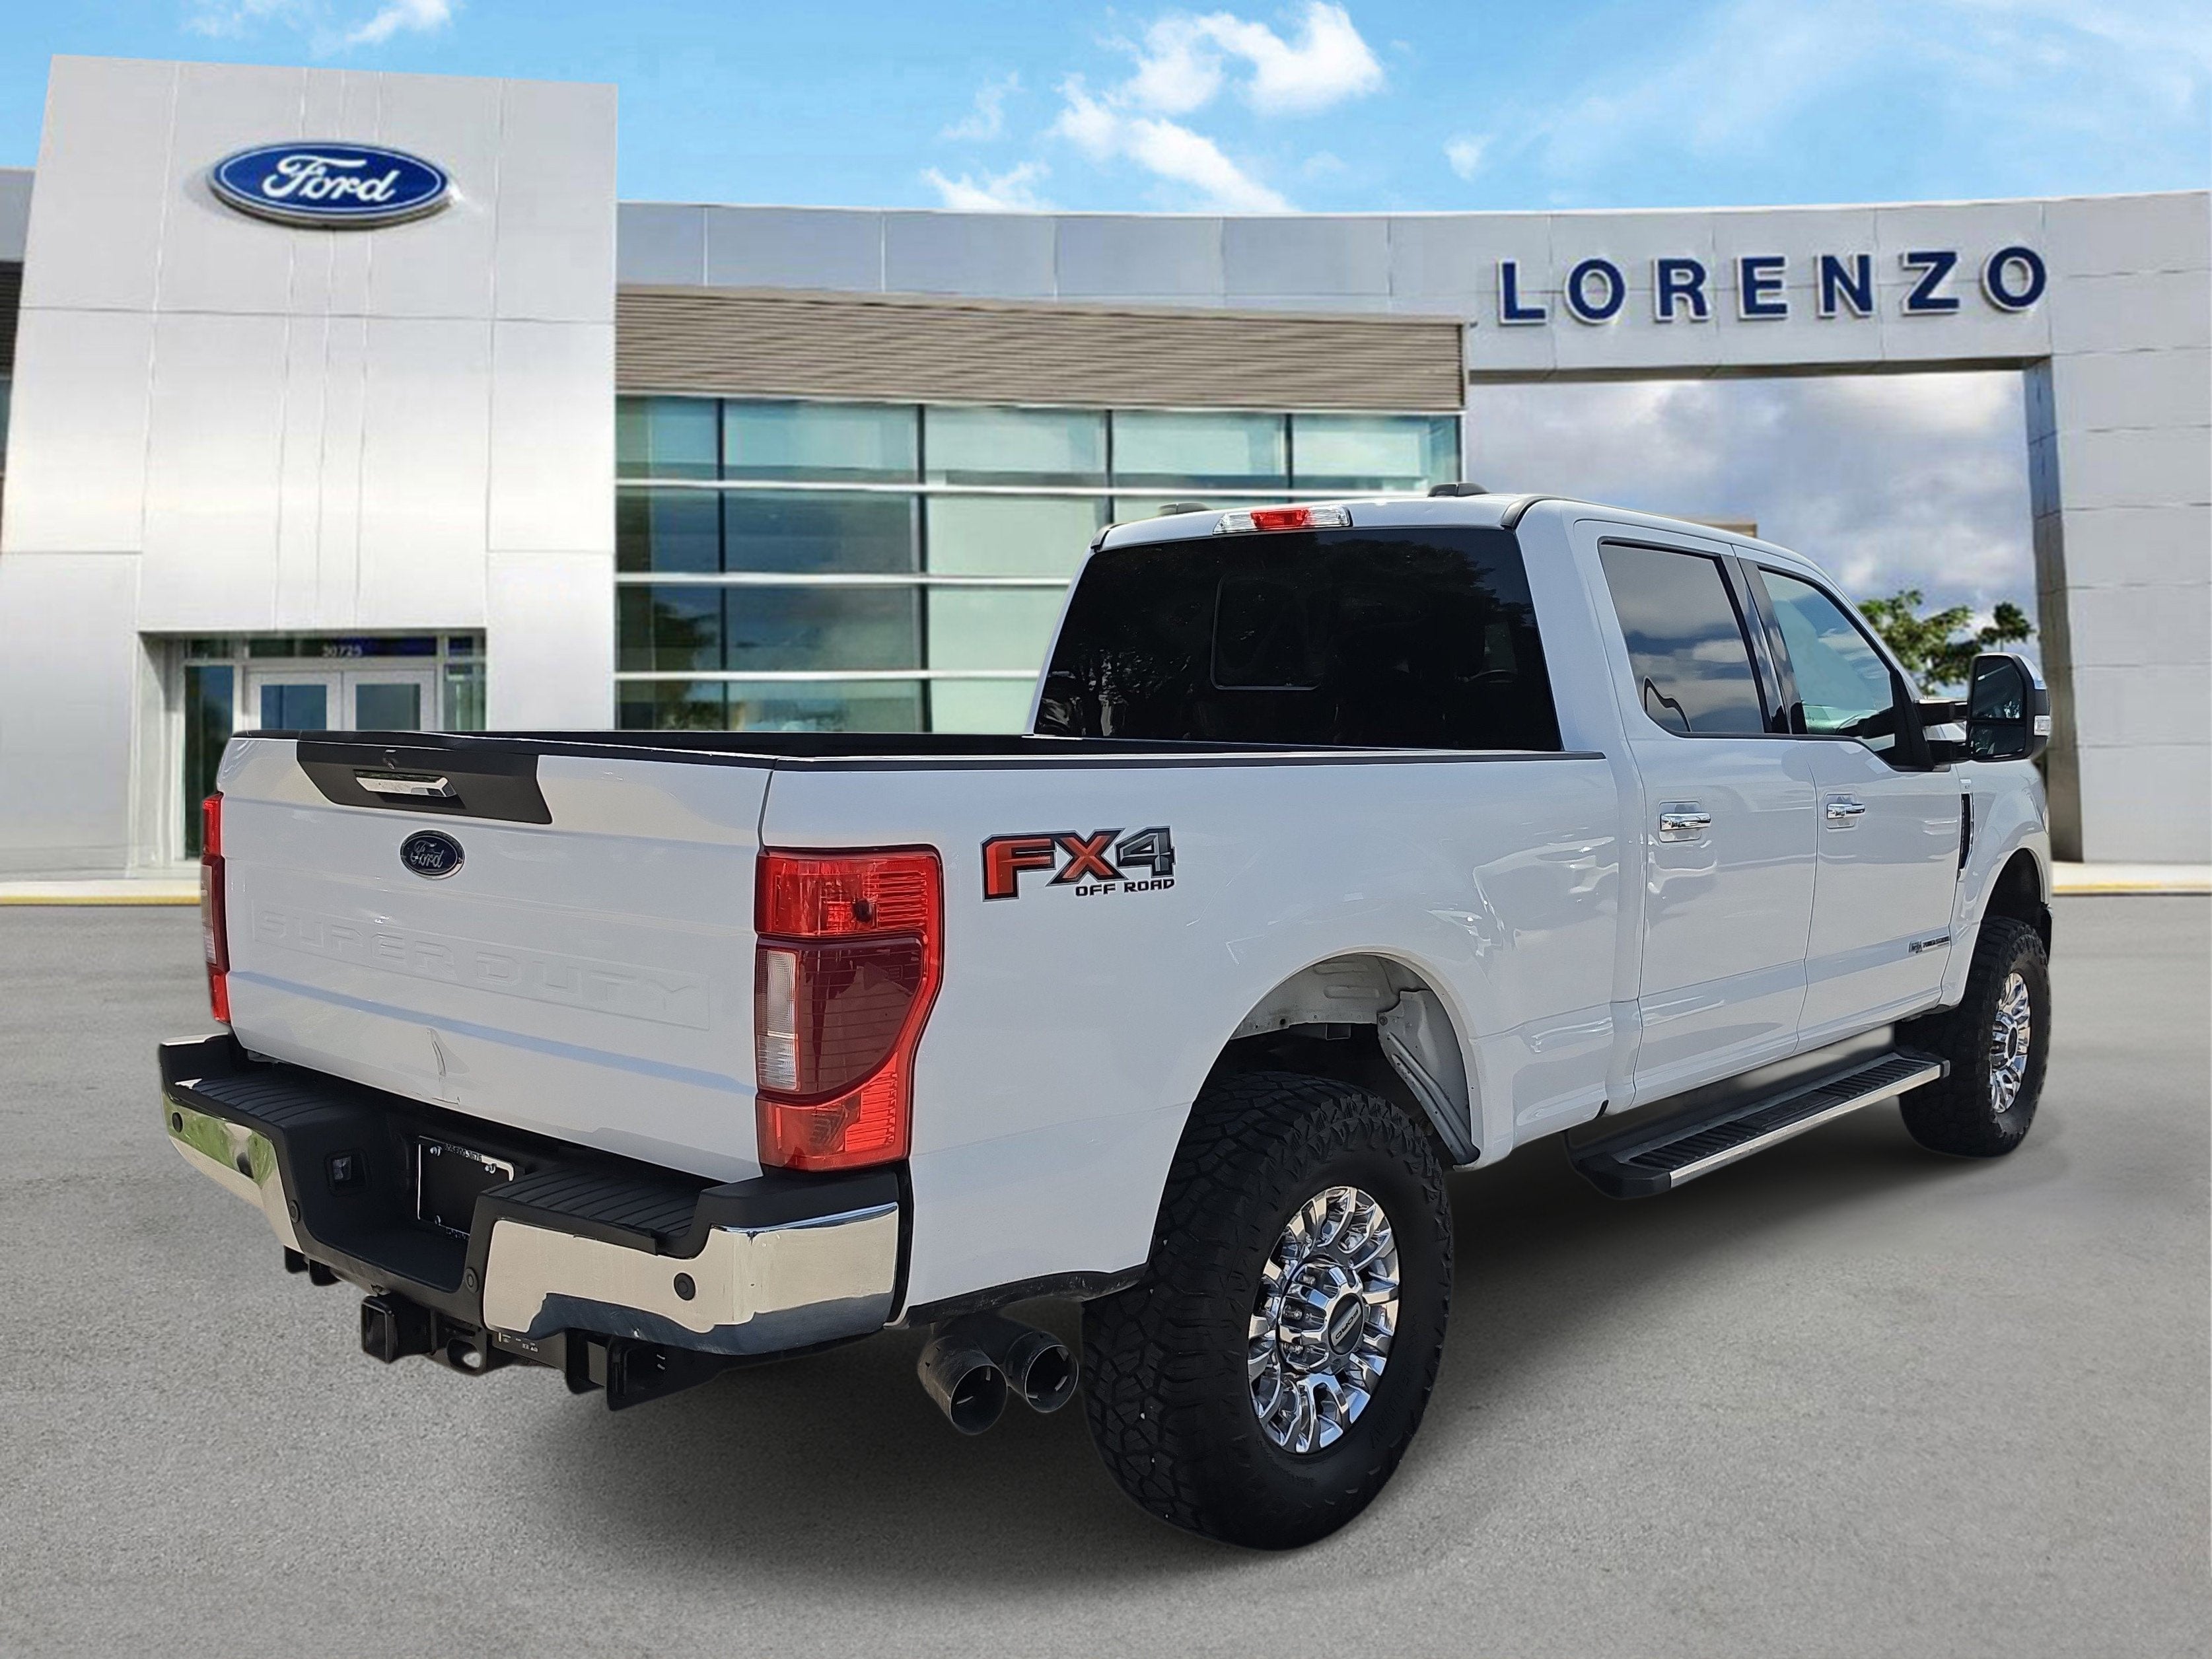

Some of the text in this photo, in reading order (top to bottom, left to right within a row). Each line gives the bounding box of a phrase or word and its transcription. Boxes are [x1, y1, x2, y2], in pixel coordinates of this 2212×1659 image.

[262, 155, 400, 201] Ford
[1498, 246, 2048, 324] LORENZO
[410, 839, 445, 869] Ford
[980, 826, 1177, 902] FX4
[1075, 878, 1175, 897] OFF ROAD
[258, 910, 699, 1010] SUPER DUTY
[1335, 1309, 1359, 1339] FORD
